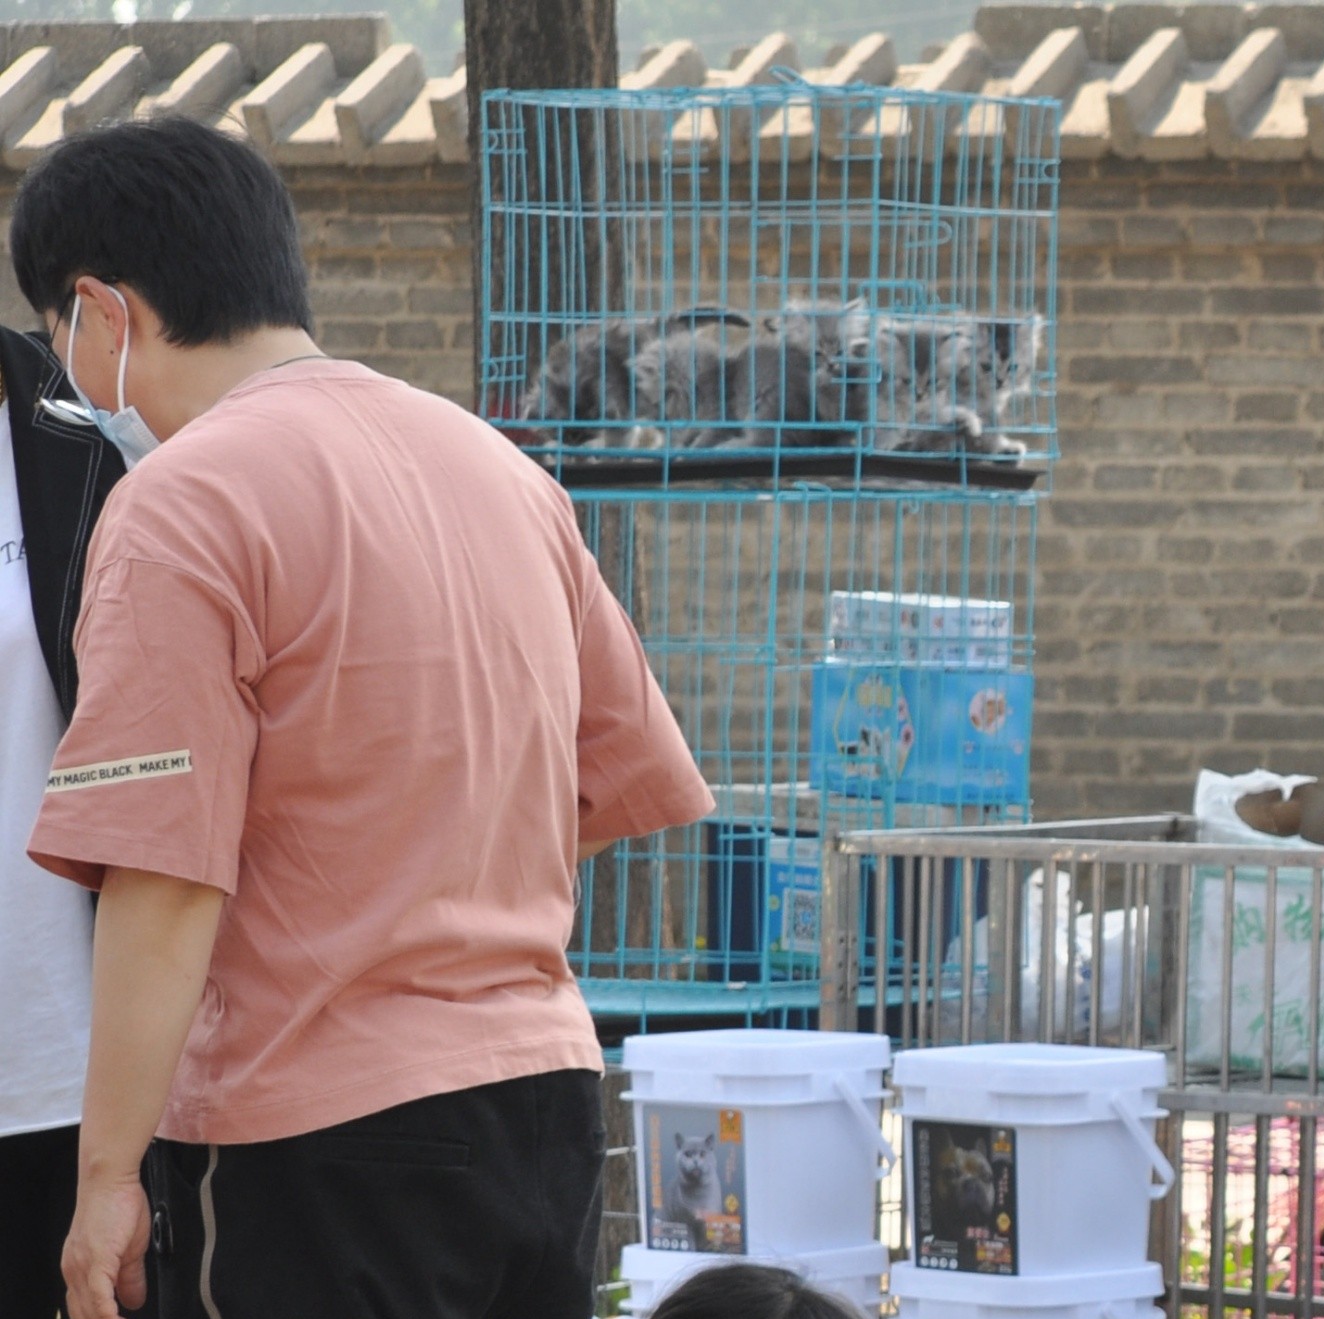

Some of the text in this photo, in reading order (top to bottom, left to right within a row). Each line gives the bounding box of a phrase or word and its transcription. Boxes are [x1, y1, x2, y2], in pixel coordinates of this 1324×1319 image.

[64, 770, 97, 784] MAGIC
[99, 764, 133, 779] BLACK
[139, 758, 169, 773] MAKE
[171, 756, 187, 769] MY
